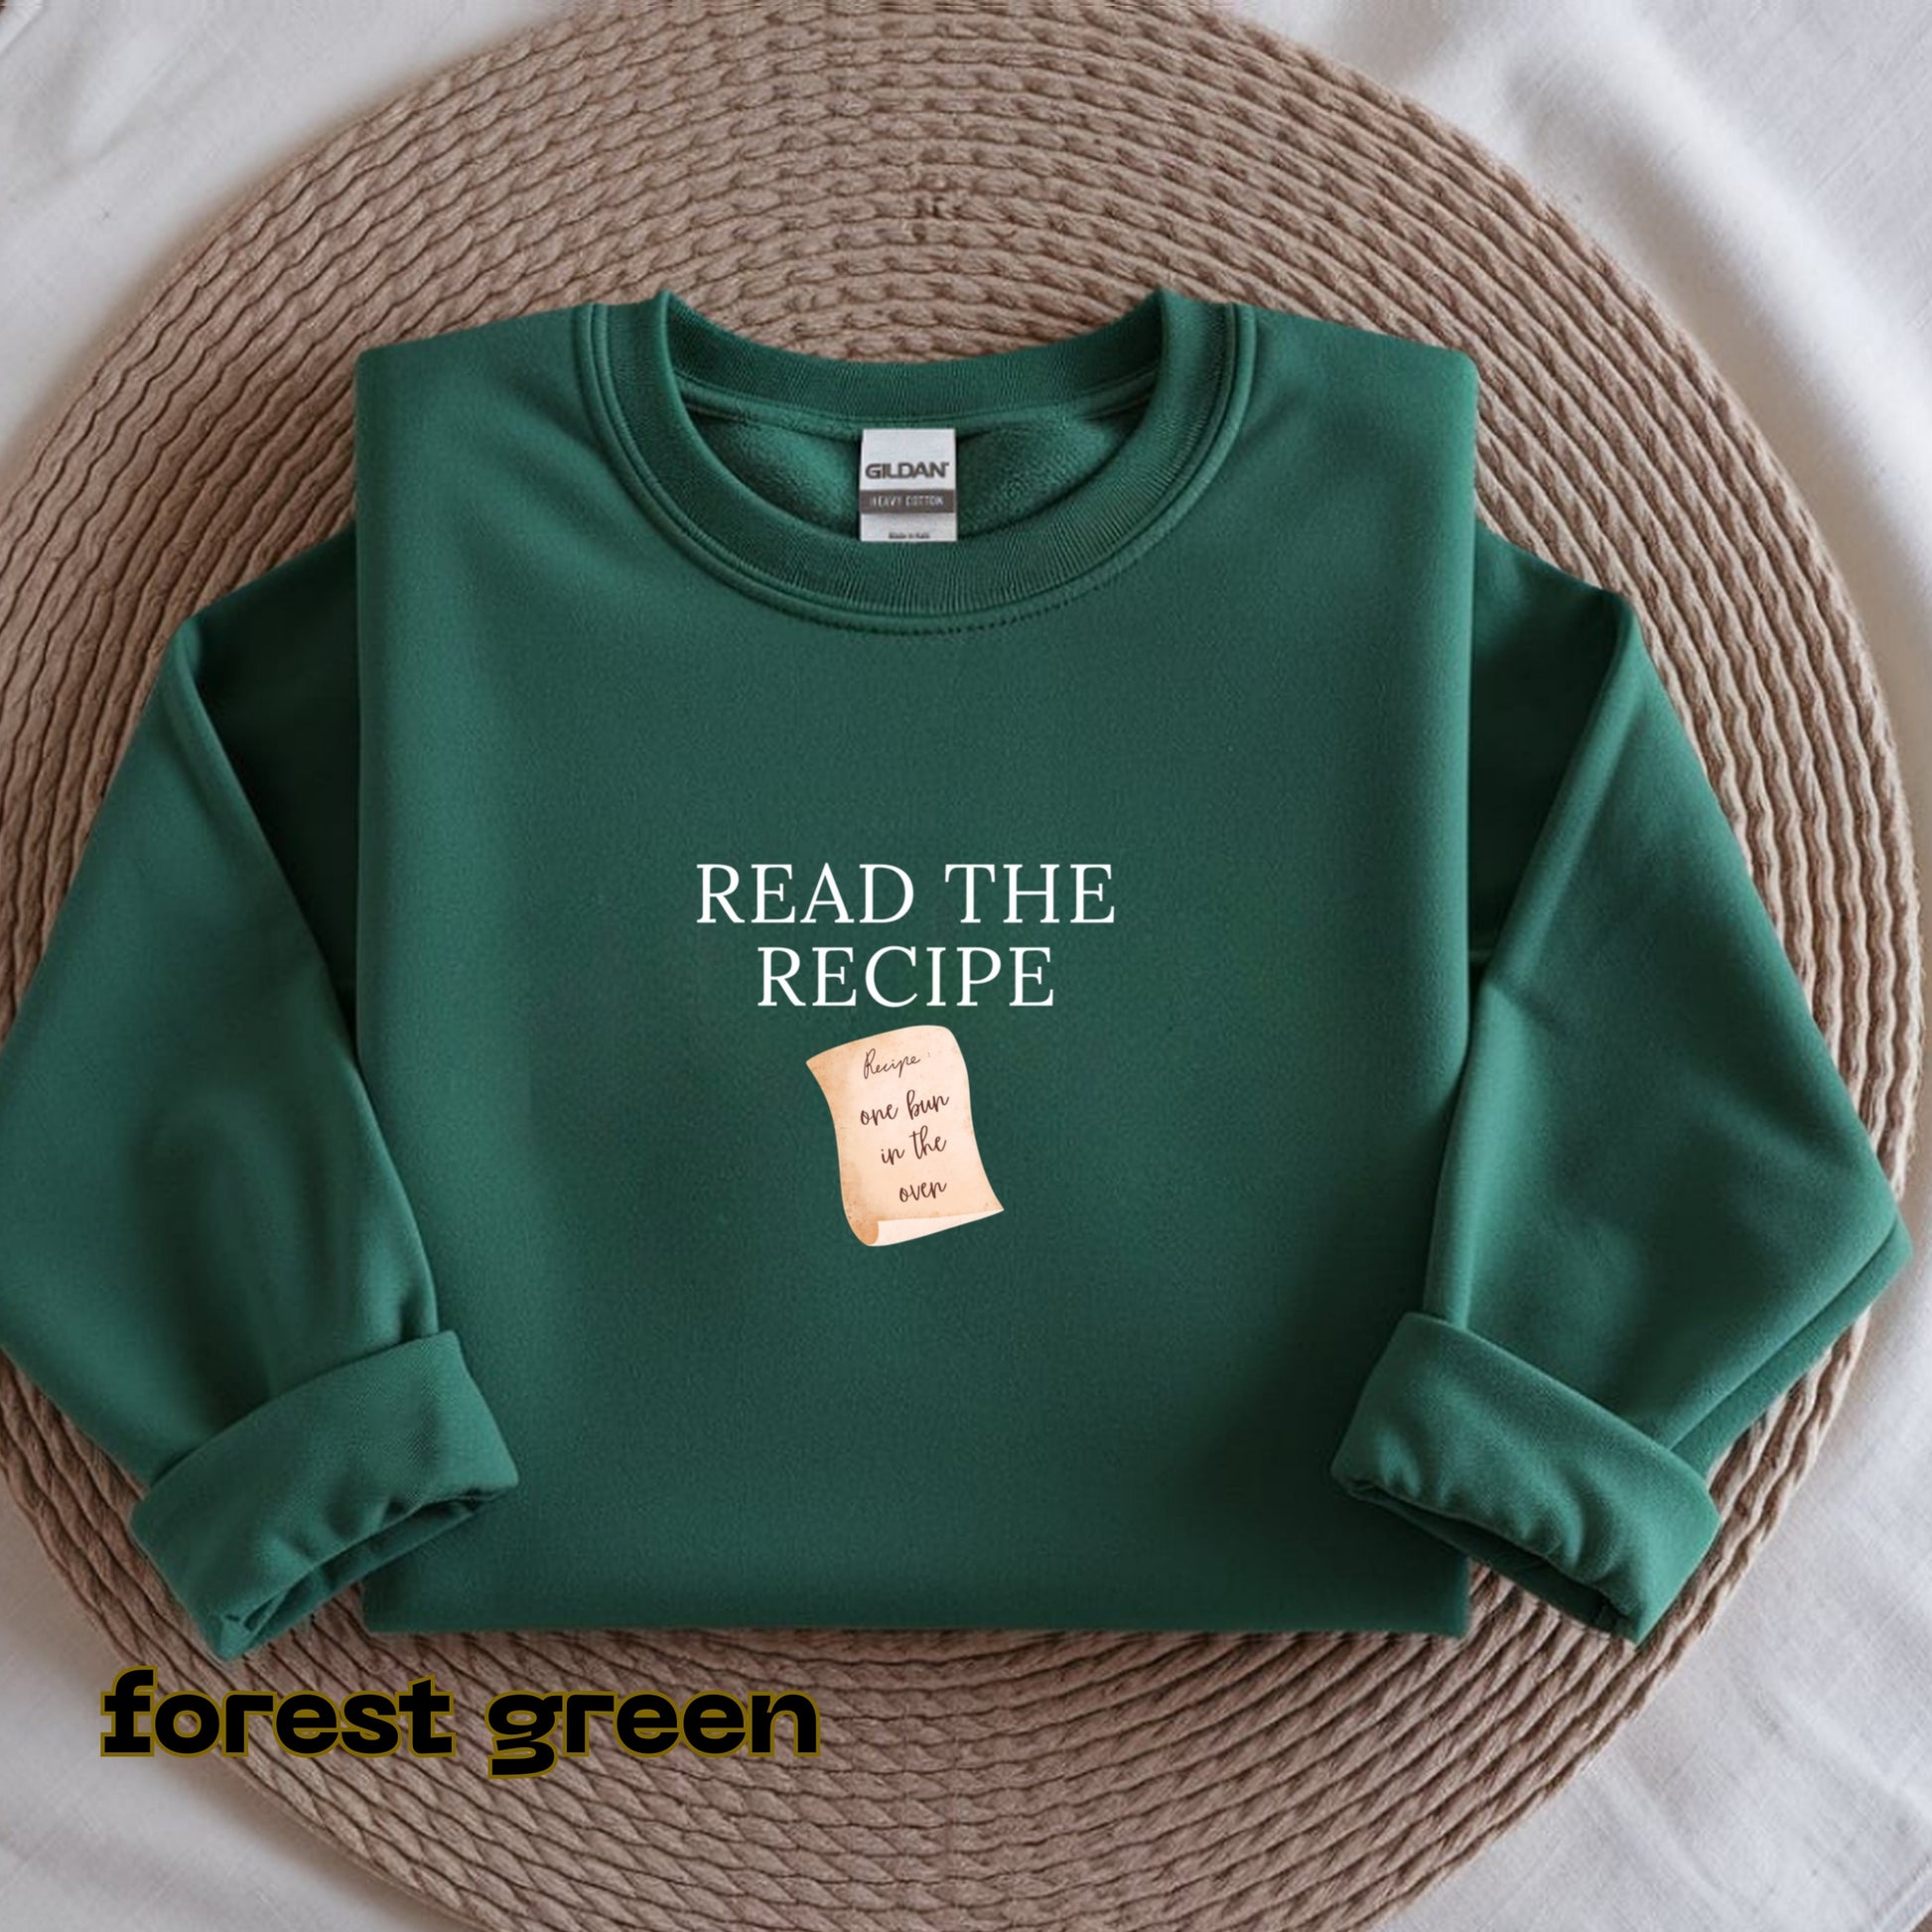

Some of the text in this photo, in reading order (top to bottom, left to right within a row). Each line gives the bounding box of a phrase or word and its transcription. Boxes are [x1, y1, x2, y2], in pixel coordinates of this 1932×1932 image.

[865, 461, 947, 480] GILDAN
[697, 863, 1115, 923] READ THE
[758, 945, 1054, 1008] RECIPE
[863, 1047, 921, 1080] Recipe
[860, 1088, 950, 1126] one bun
[881, 1124, 947, 1166] in the
[898, 1180, 947, 1202] oven
